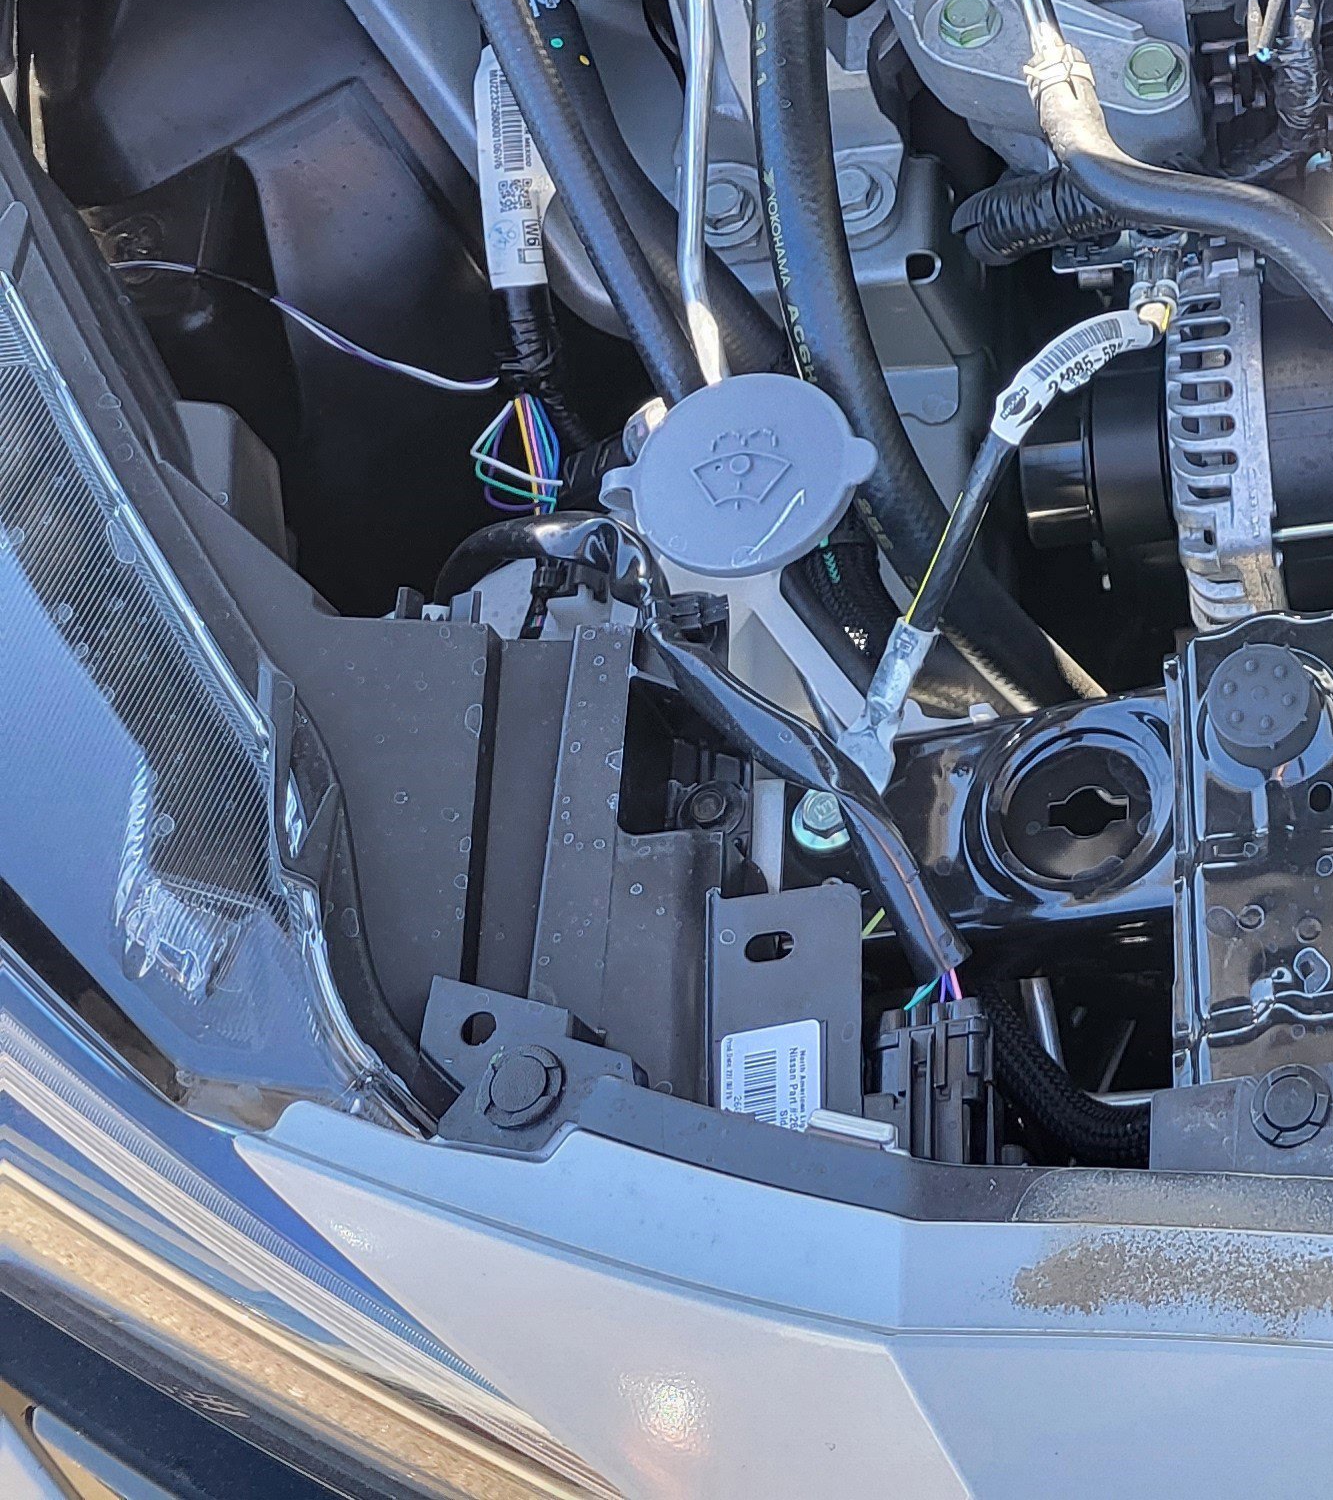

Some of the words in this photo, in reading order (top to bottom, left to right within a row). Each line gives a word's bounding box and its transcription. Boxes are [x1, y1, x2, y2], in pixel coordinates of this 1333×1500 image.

[525, 222, 541, 247] W6
[766, 193, 791, 289] YOKOHAMA
[1000, 386, 1029, 420] NISSAN
[789, 1047, 798, 1080] Nissan
[789, 1083, 798, 1105] Part
